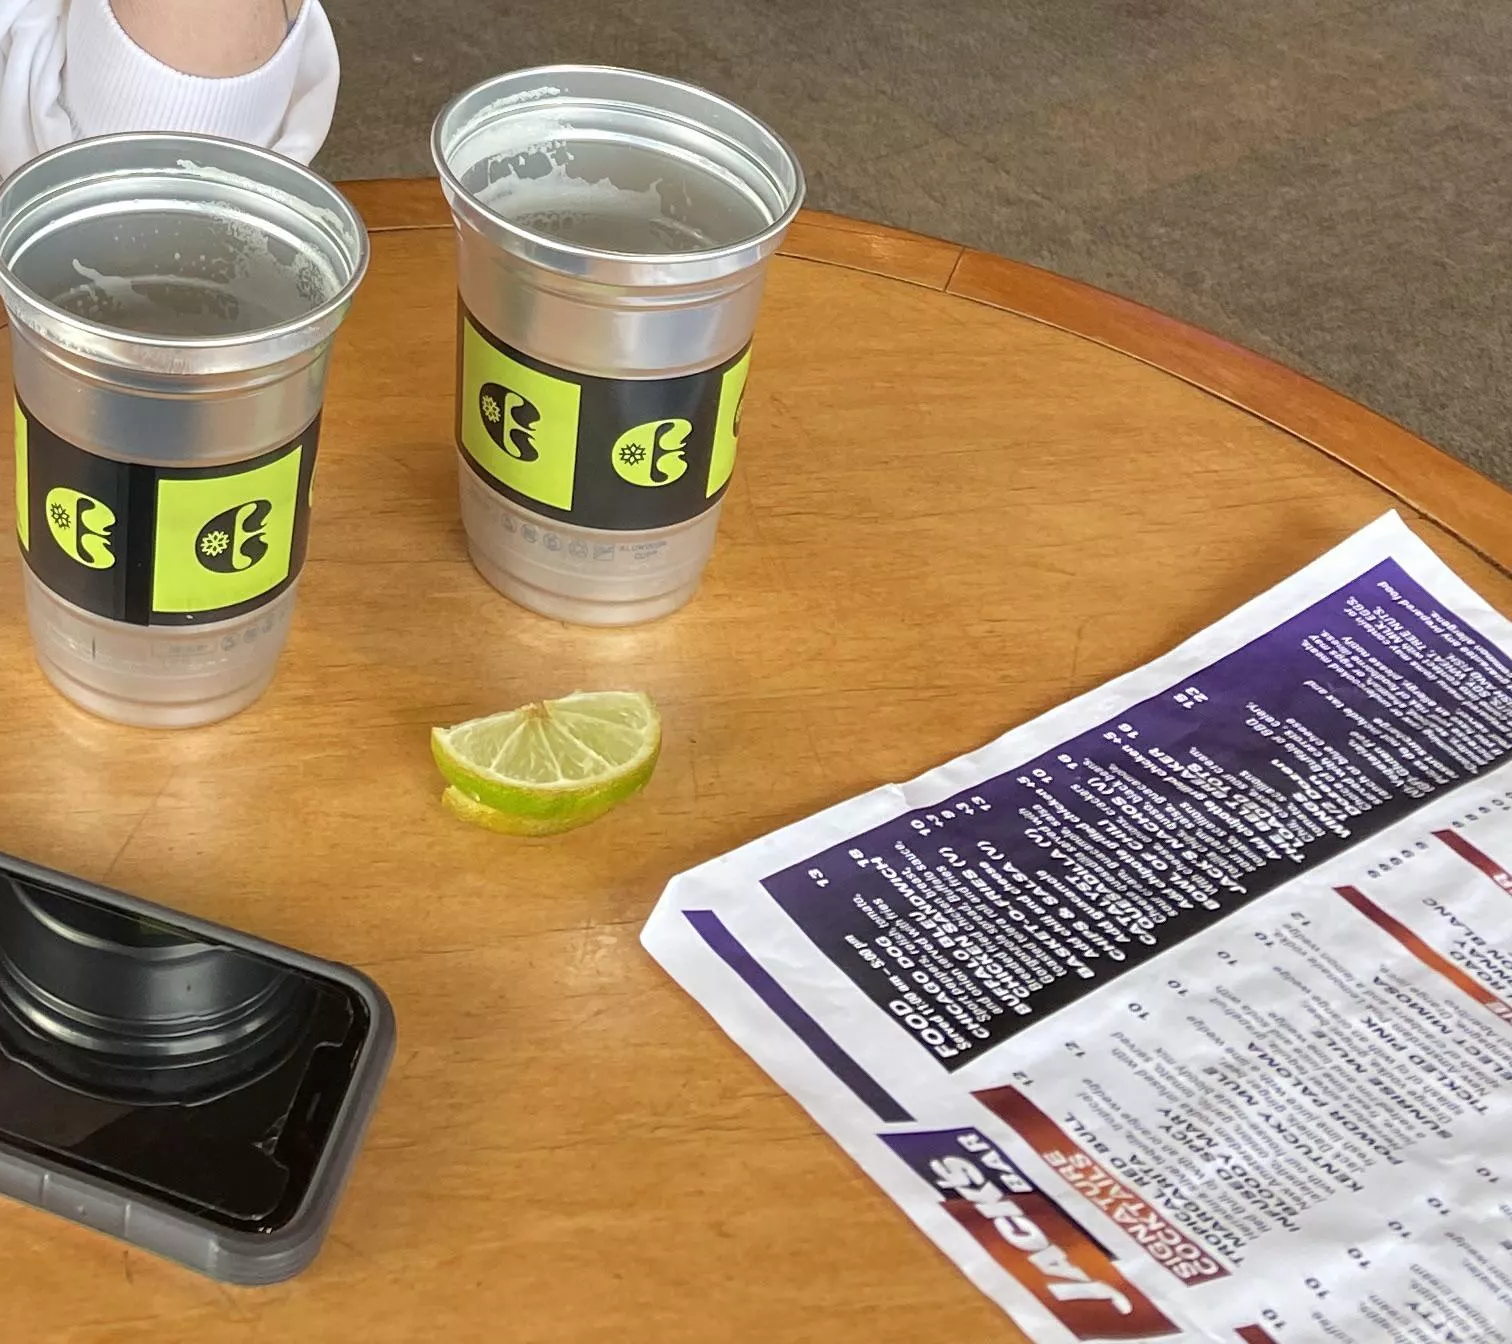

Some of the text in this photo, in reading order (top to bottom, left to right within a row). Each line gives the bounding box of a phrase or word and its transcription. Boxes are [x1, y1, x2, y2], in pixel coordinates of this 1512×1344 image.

[1172, 692, 1195, 709] 15
[1184, 686, 1209, 703] 23
[1015, 775, 1195, 909] Add chipotle grilled chicken +5
[1031, 767, 1221, 911] BOWL OF CHILI 10
[1056, 753, 1247, 895] JACK'S NACHOS (V) 16
[1102, 731, 1282, 860] Add chipotle grilled chicken +5
[1117, 722, 1305, 863] THE BELT BREAKER 16
[1186, 762, 1305, 848] LOADED TOTS
[1270, 758, 1349, 822] 1/2 Dozen
[1291, 791, 1351, 839] WINGS
[1308, 774, 1362, 816] Dozen
[847, 847, 1033, 1015] BUFFALO BLEU 18
[869, 855, 1031, 999] CHICKEN SANDWICH
[893, 840, 1055, 985] Gorgonzola spread, Buffalo sauce,
[900, 866, 1044, 992] Breaded fried chicken breast,
[909, 818, 1095, 979] BASKET-O-FRIES (V) 10
[925, 813, 1100, 958] Add chili and cheese +3
[935, 865, 1068, 977] toasted telera roll and fries
[940, 809, 1126, 961] CHIPS & SALSA (V) 9
[955, 801, 1131, 943] Add guacamole +3
[970, 795, 1157, 945] CATALYST 13
[1023, 827, 1155, 930] QUESADILLA (V)
[1289, 911, 1312, 927] 12
[1421, 897, 1487, 947] BLANC
[807, 867, 990, 1039] CHICAGO DOG 13
[843, 933, 973, 1051] Served 11:00 am 5:00 pm
[852, 893, 992, 1023] Sport peppers, relish, tomato,
[871, 897, 1004, 1015] and onion served with fries
[1372, 975, 1453, 1035] MIMOSA
[888, 999, 959, 1058] FOOD
[1167, 979, 1404, 1166] POWDR PALOMA 10
[1216, 950, 1453, 1139] SUNRISE MULE 10
[1253, 931, 1489, 1113] TICKLED PINK 10
[1064, 1041, 1301, 1233] INFUSED SPICY 12
[1127, 1002, 1365, 1193] KENTUCKY MULE 10
[954, 1131, 1036, 1193] BAR
[1011, 1071, 1245, 1265] TROPICAL RED BULL 12
[1038, 1148, 1200, 1280] SIGNATURE
[1064, 1150, 1223, 1277] COCKTAILS
[1128, 1155, 1247, 1249] MARGARITA
[1157, 1108, 1299, 1217] BLOODY MARY
[1427, 1197, 1451, 1216] 10
[1475, 1167, 1499, 1184] 10
[927, 1154, 1134, 1315] JACK'S
[1304, 1277, 1329, 1299] 10
[1346, 1247, 1371, 1268] 10
[1387, 1220, 1411, 1239] 10
[1261, 1308, 1286, 1329] 10
